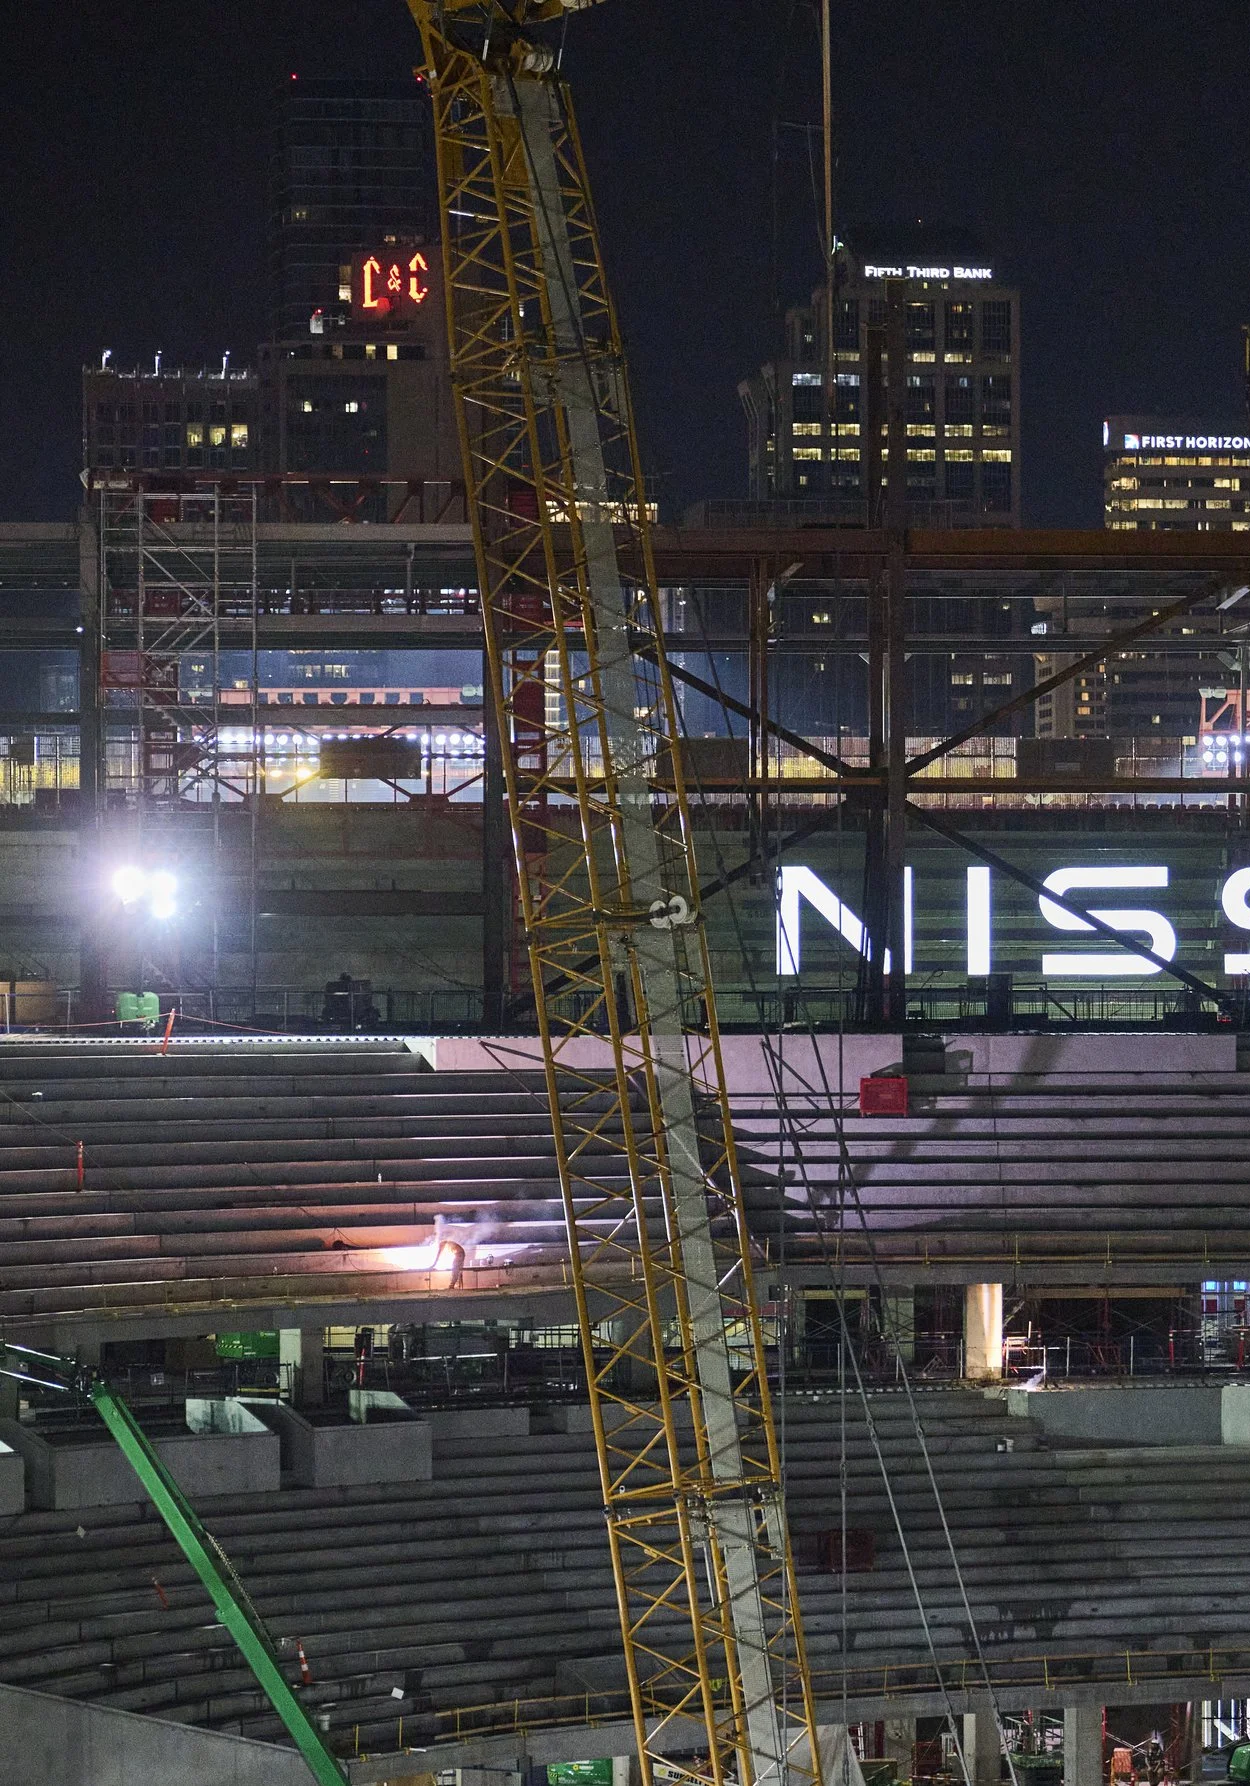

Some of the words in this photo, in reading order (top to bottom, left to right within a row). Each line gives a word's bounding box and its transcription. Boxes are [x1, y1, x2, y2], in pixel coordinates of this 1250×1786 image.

[864, 265, 902, 278] FIFTH
[906, 265, 949, 279] THIRD
[953, 266, 992, 279] BANK
[1141, 436, 1183, 449] FIRST
